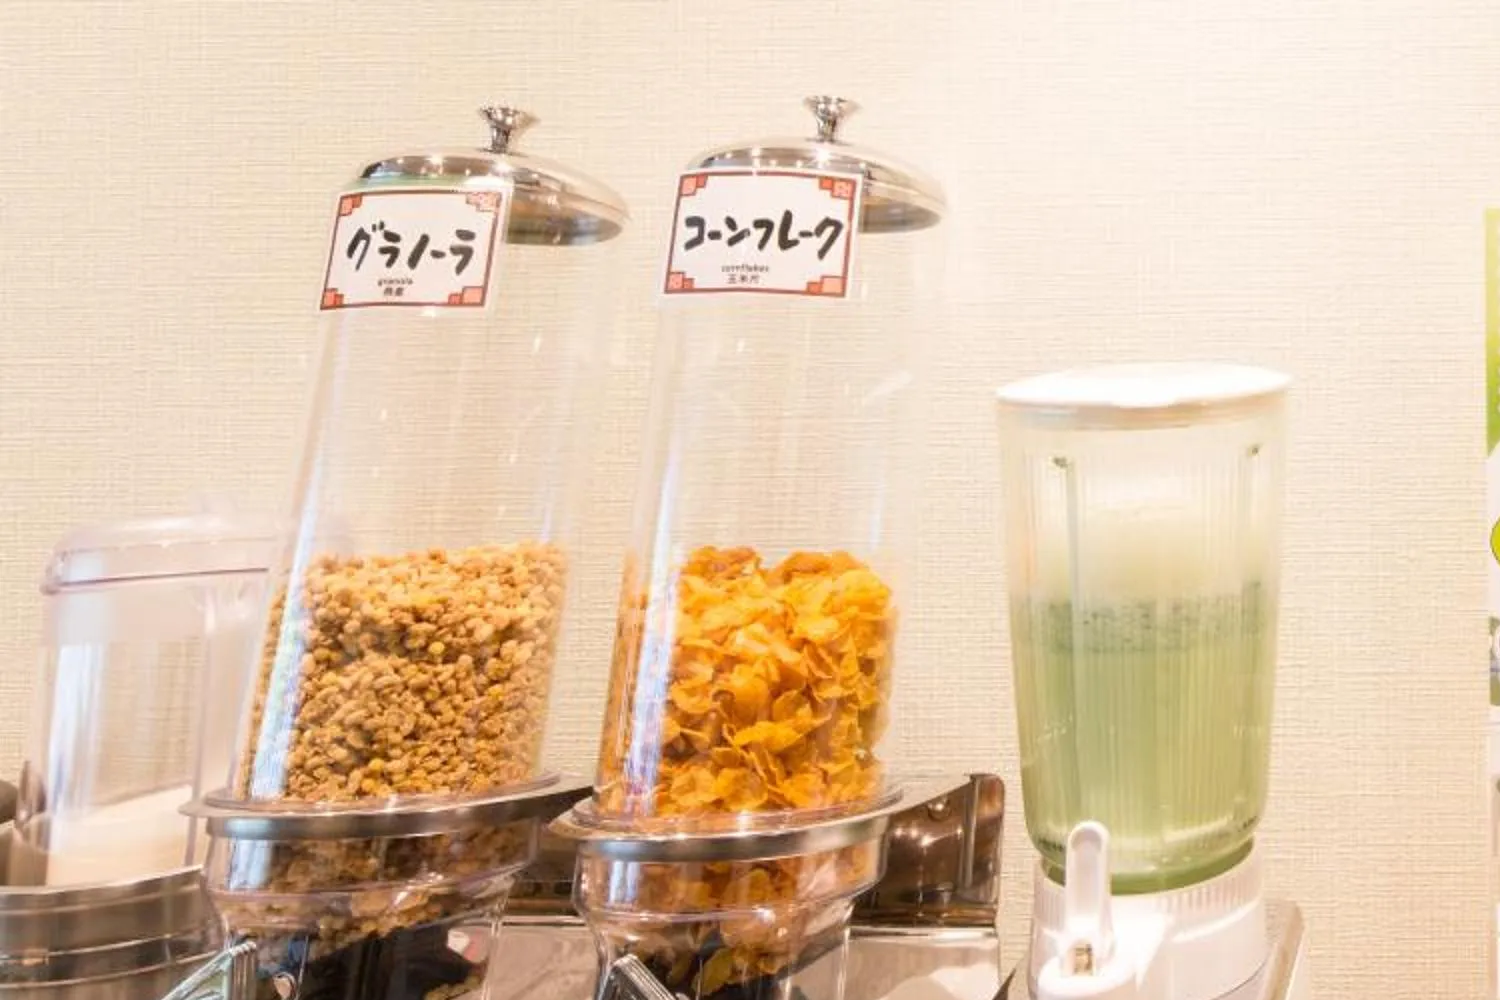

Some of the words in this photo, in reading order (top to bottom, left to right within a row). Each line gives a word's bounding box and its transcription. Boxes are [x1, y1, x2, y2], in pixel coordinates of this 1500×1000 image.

[347, 221, 476, 276] グラノーラ
[684, 210, 843, 260] コーンフレーク
